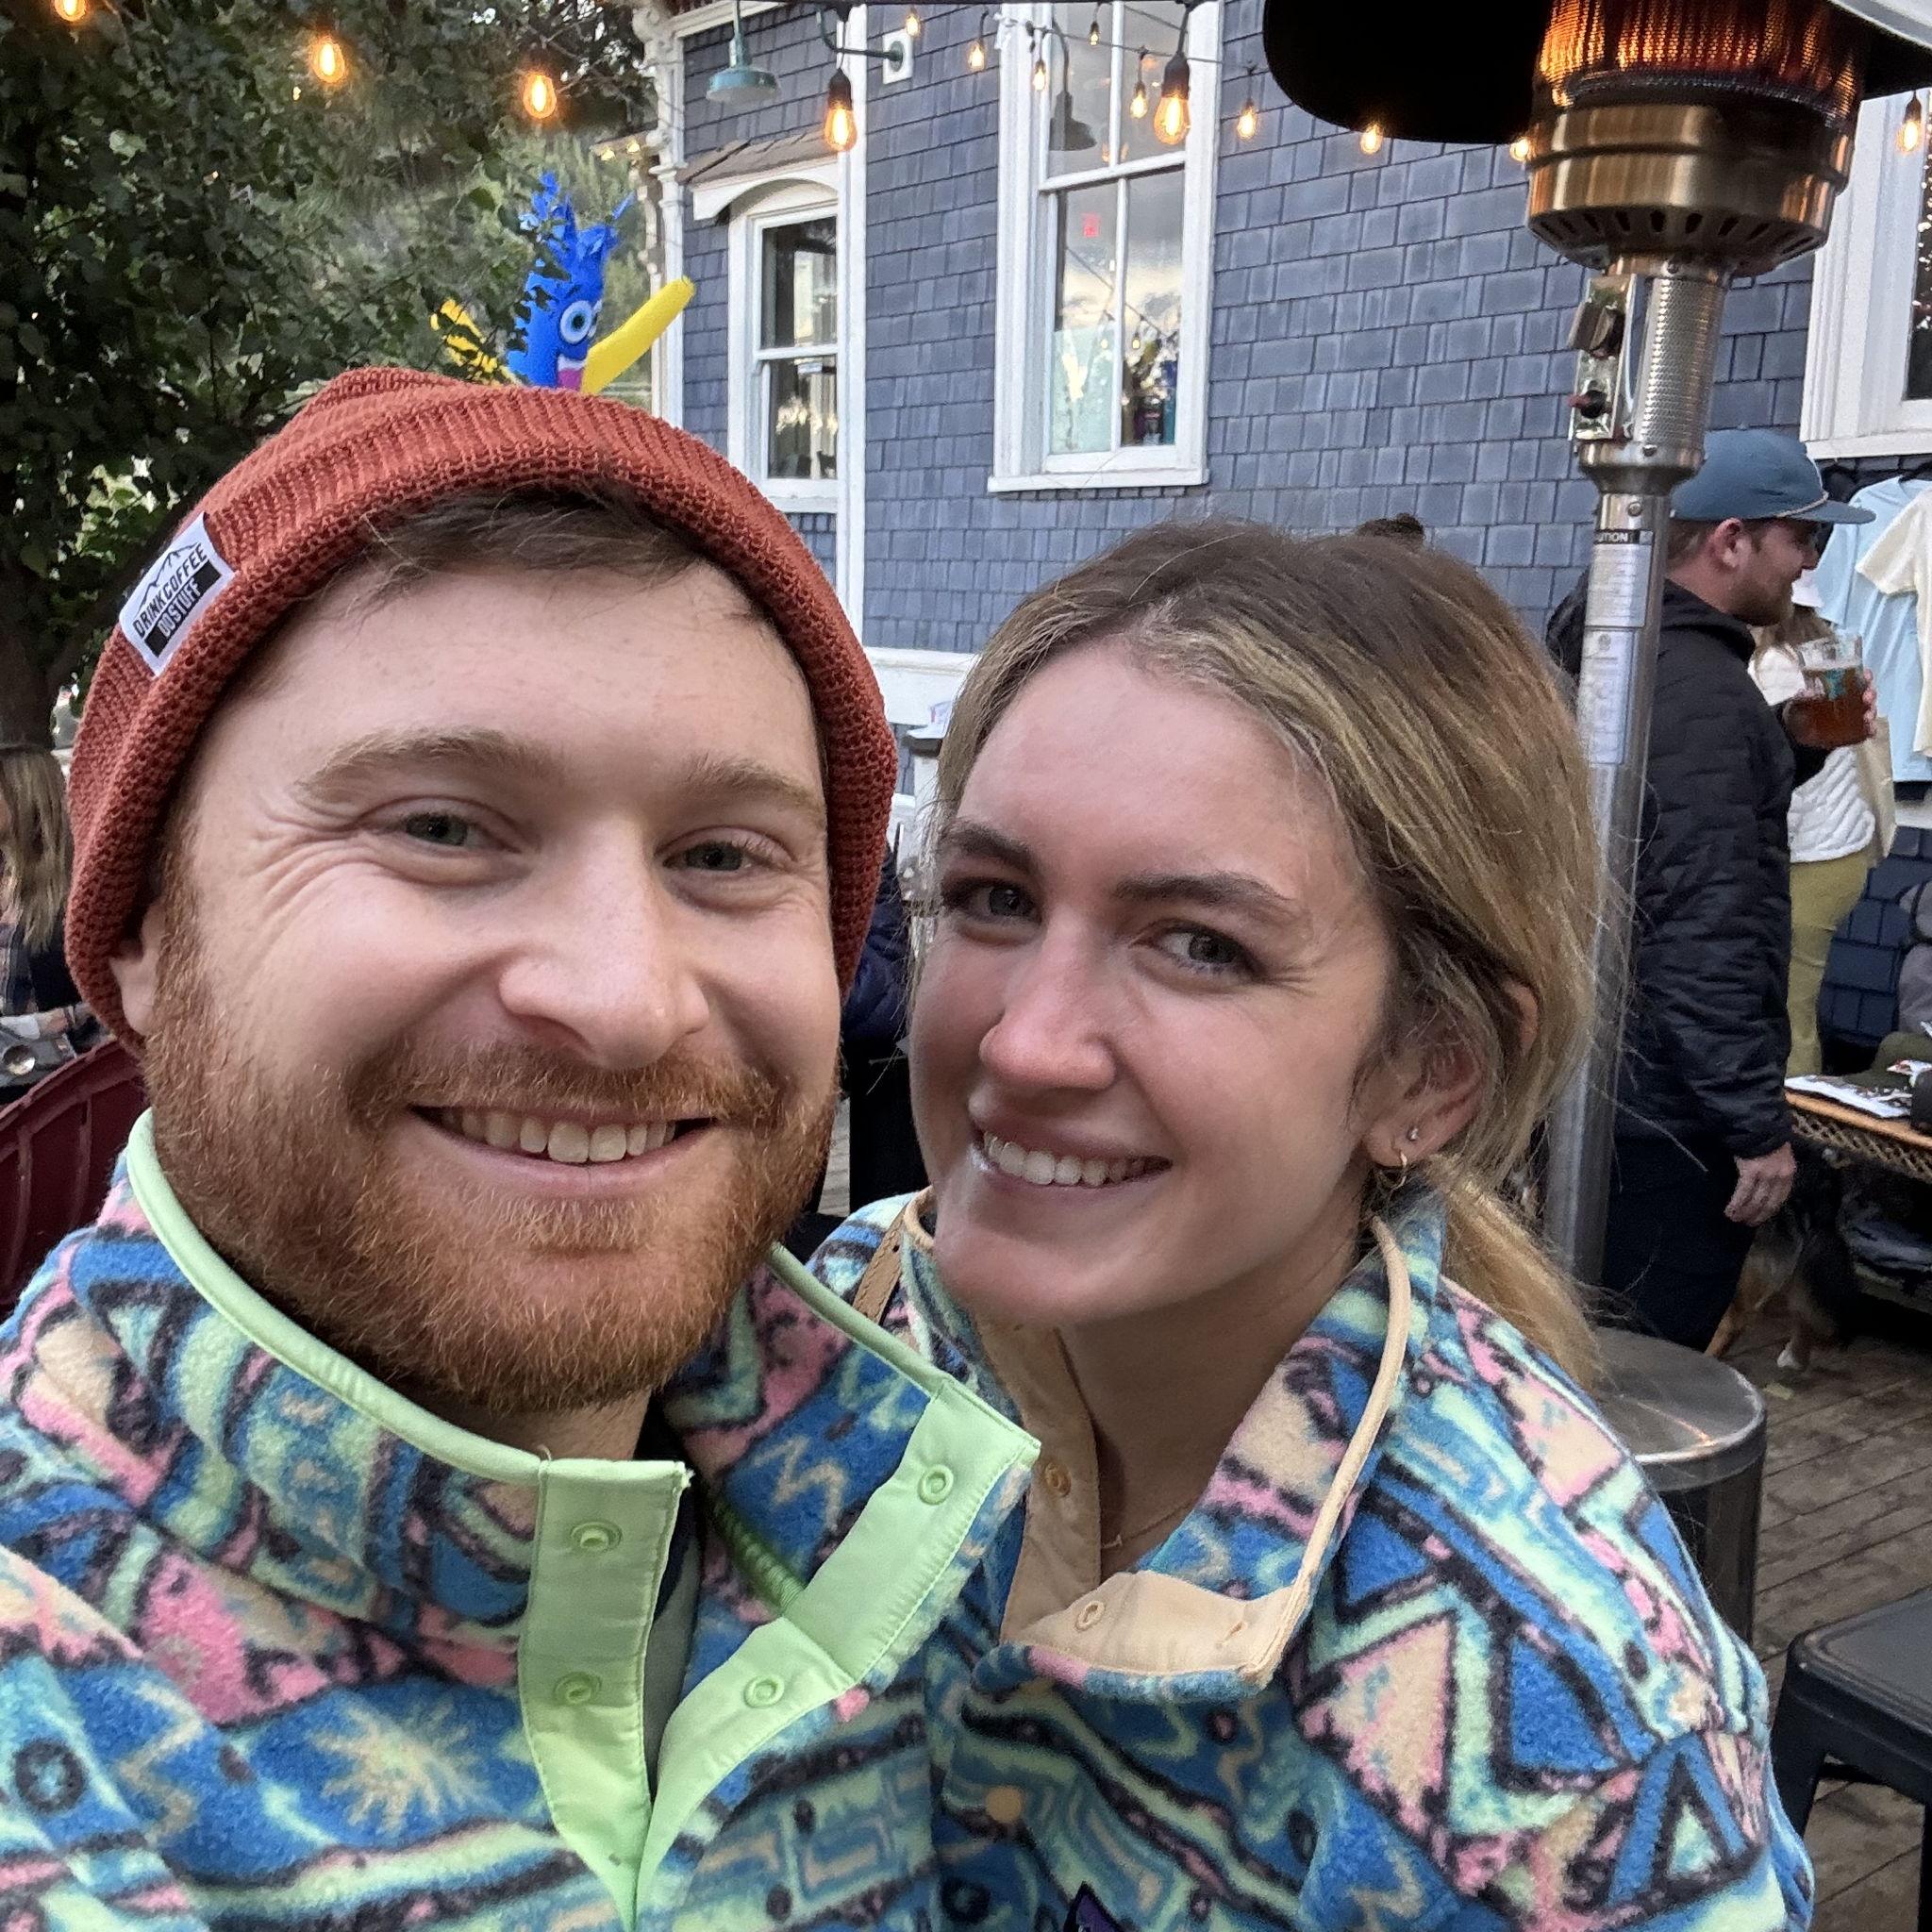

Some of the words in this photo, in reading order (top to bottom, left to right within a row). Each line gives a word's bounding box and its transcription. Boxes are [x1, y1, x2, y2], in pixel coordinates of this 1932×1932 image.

[132, 591, 167, 638] DRINK
[161, 542, 207, 599] COFFEE
[168, 577, 201, 623] STUFF
